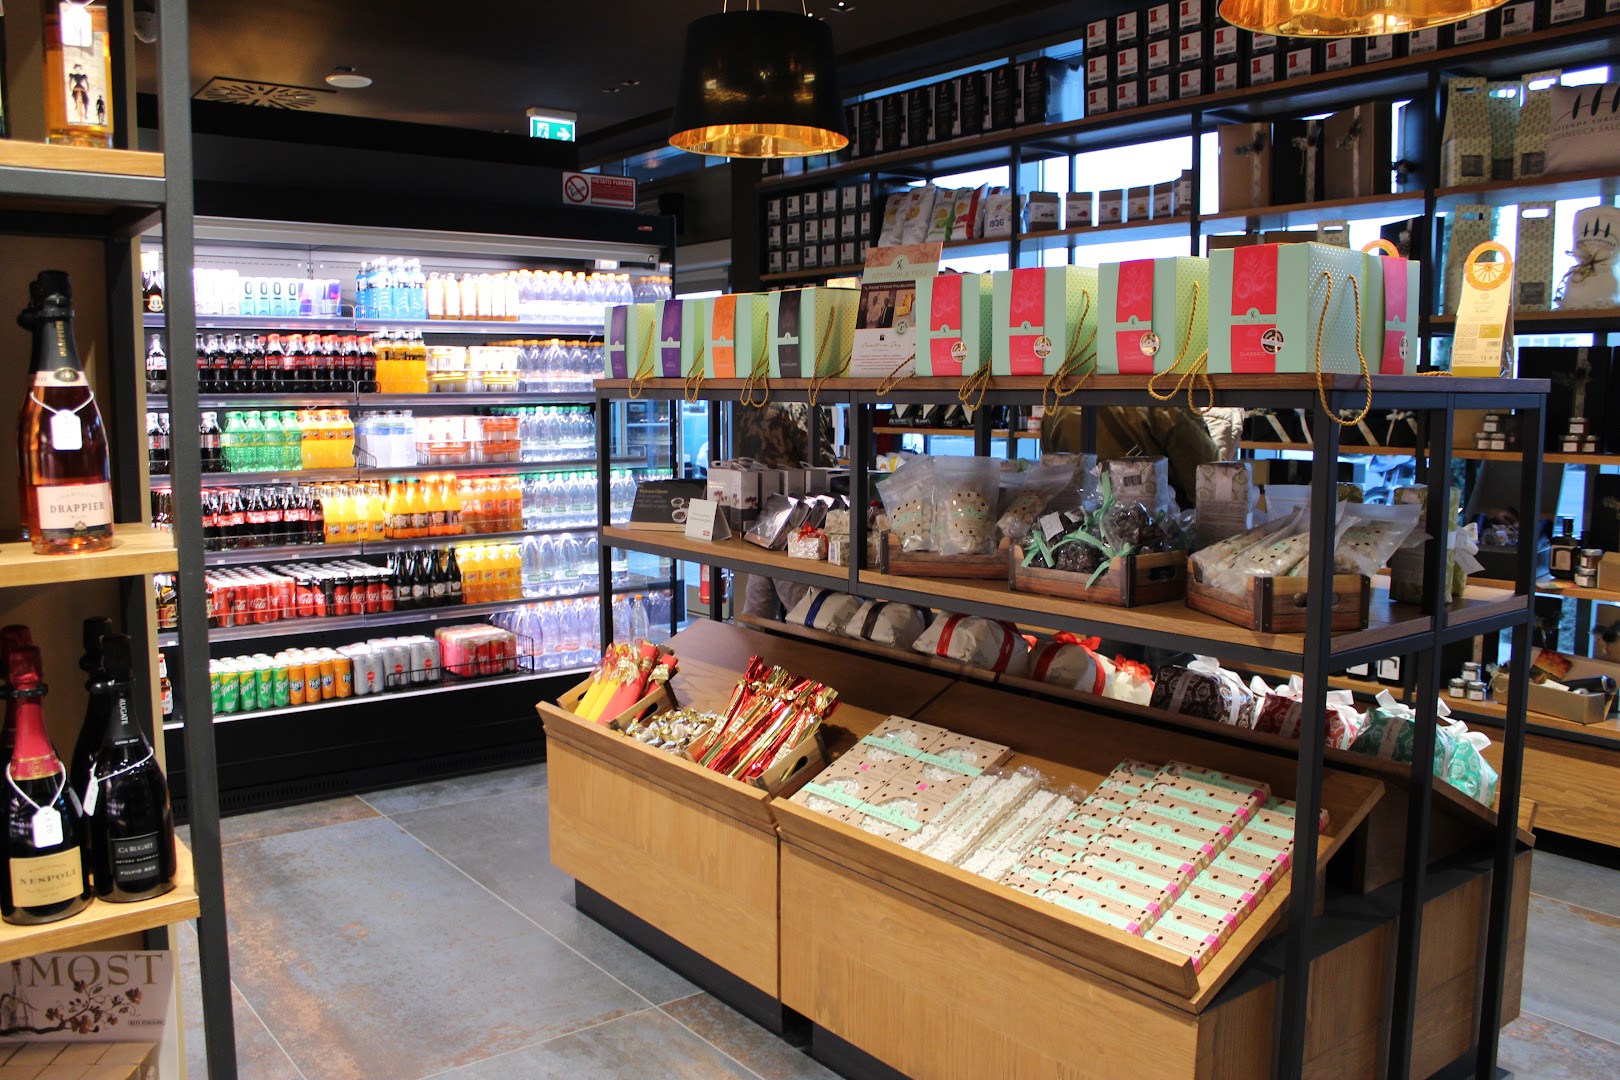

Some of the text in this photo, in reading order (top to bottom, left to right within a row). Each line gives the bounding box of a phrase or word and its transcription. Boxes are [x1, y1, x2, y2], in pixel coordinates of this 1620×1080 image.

[990, 219, 1004, 228] 1936
[50, 502, 104, 513] DRAPPIER
[20, 869, 76, 885] NESPOLI
[26, 952, 163, 988] MOST
